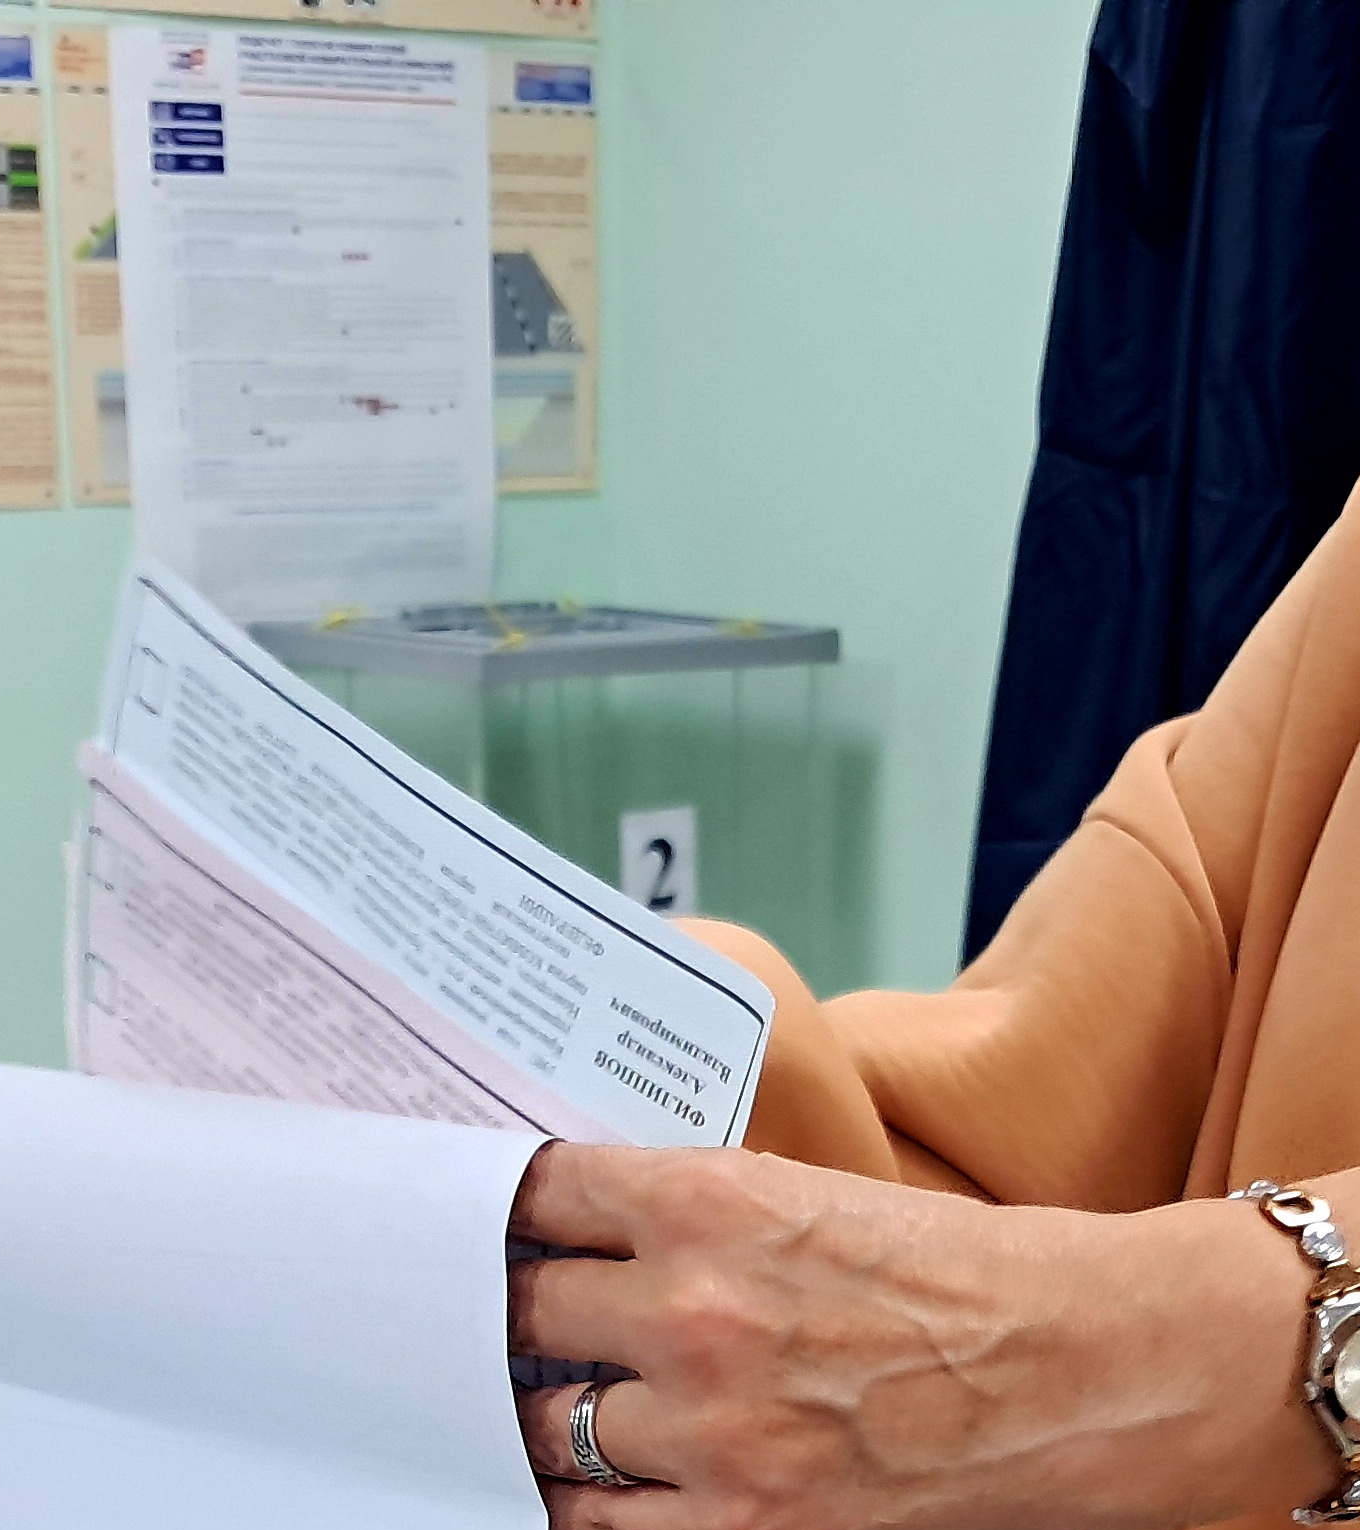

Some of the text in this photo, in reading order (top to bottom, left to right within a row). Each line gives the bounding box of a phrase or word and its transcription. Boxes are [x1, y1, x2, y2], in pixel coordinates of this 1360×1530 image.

[644, 837, 677, 910] 2
[608, 997, 732, 1085] Владимирович
[616, 1030, 707, 1096] Александр
[593, 1049, 706, 1128] ФИЛИППОВ
